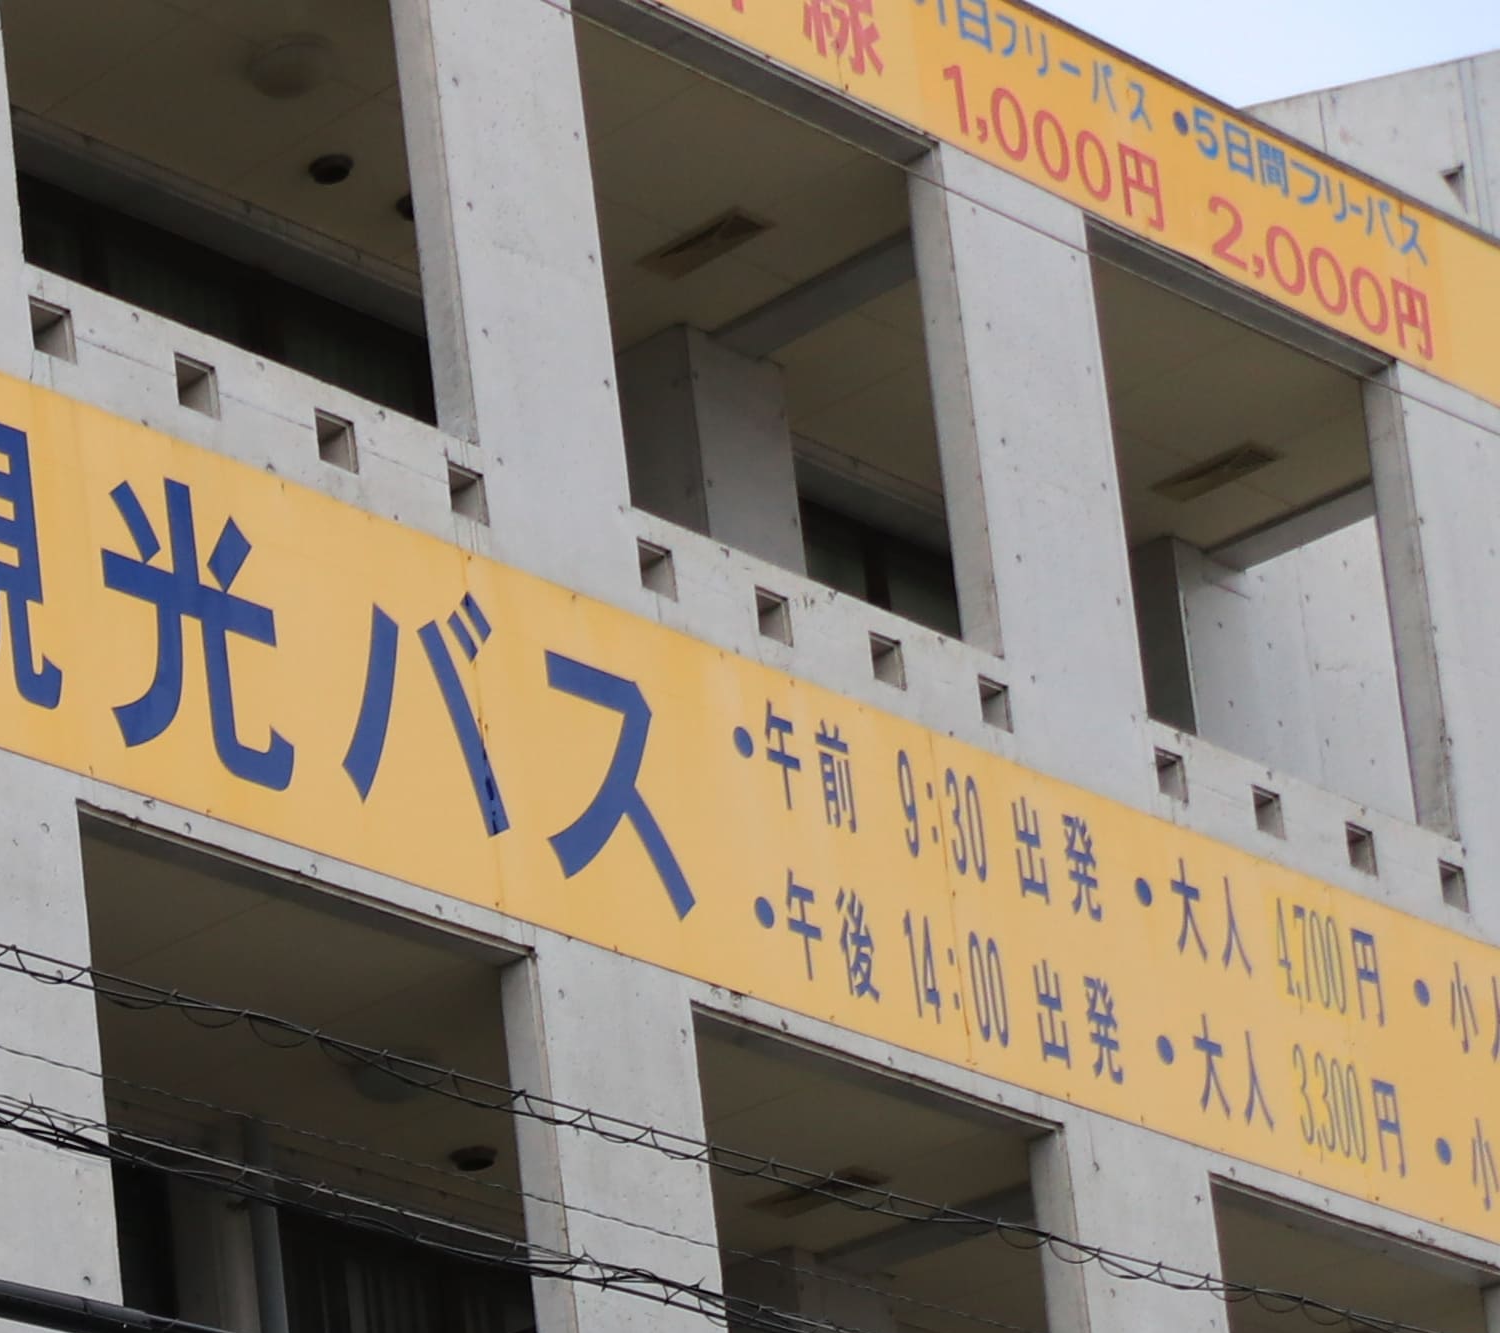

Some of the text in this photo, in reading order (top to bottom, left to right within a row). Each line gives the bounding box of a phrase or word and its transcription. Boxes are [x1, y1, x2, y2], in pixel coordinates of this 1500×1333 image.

[943, 64, 1165, 232] 1,000円
[1191, 107, 1430, 266] 5日間フリーパス
[1210, 195, 1435, 362] 2,000円
[764, 700, 858, 834] 午前
[897, 749, 988, 884] 9:30
[1011, 796, 1102, 922] 出発
[1170, 857, 1254, 979] 大人
[785, 868, 881, 1004] 午後
[903, 909, 1010, 1049] 14:00
[1031, 959, 1125, 1085] 出発
[1192, 1013, 1275, 1132] 大人
